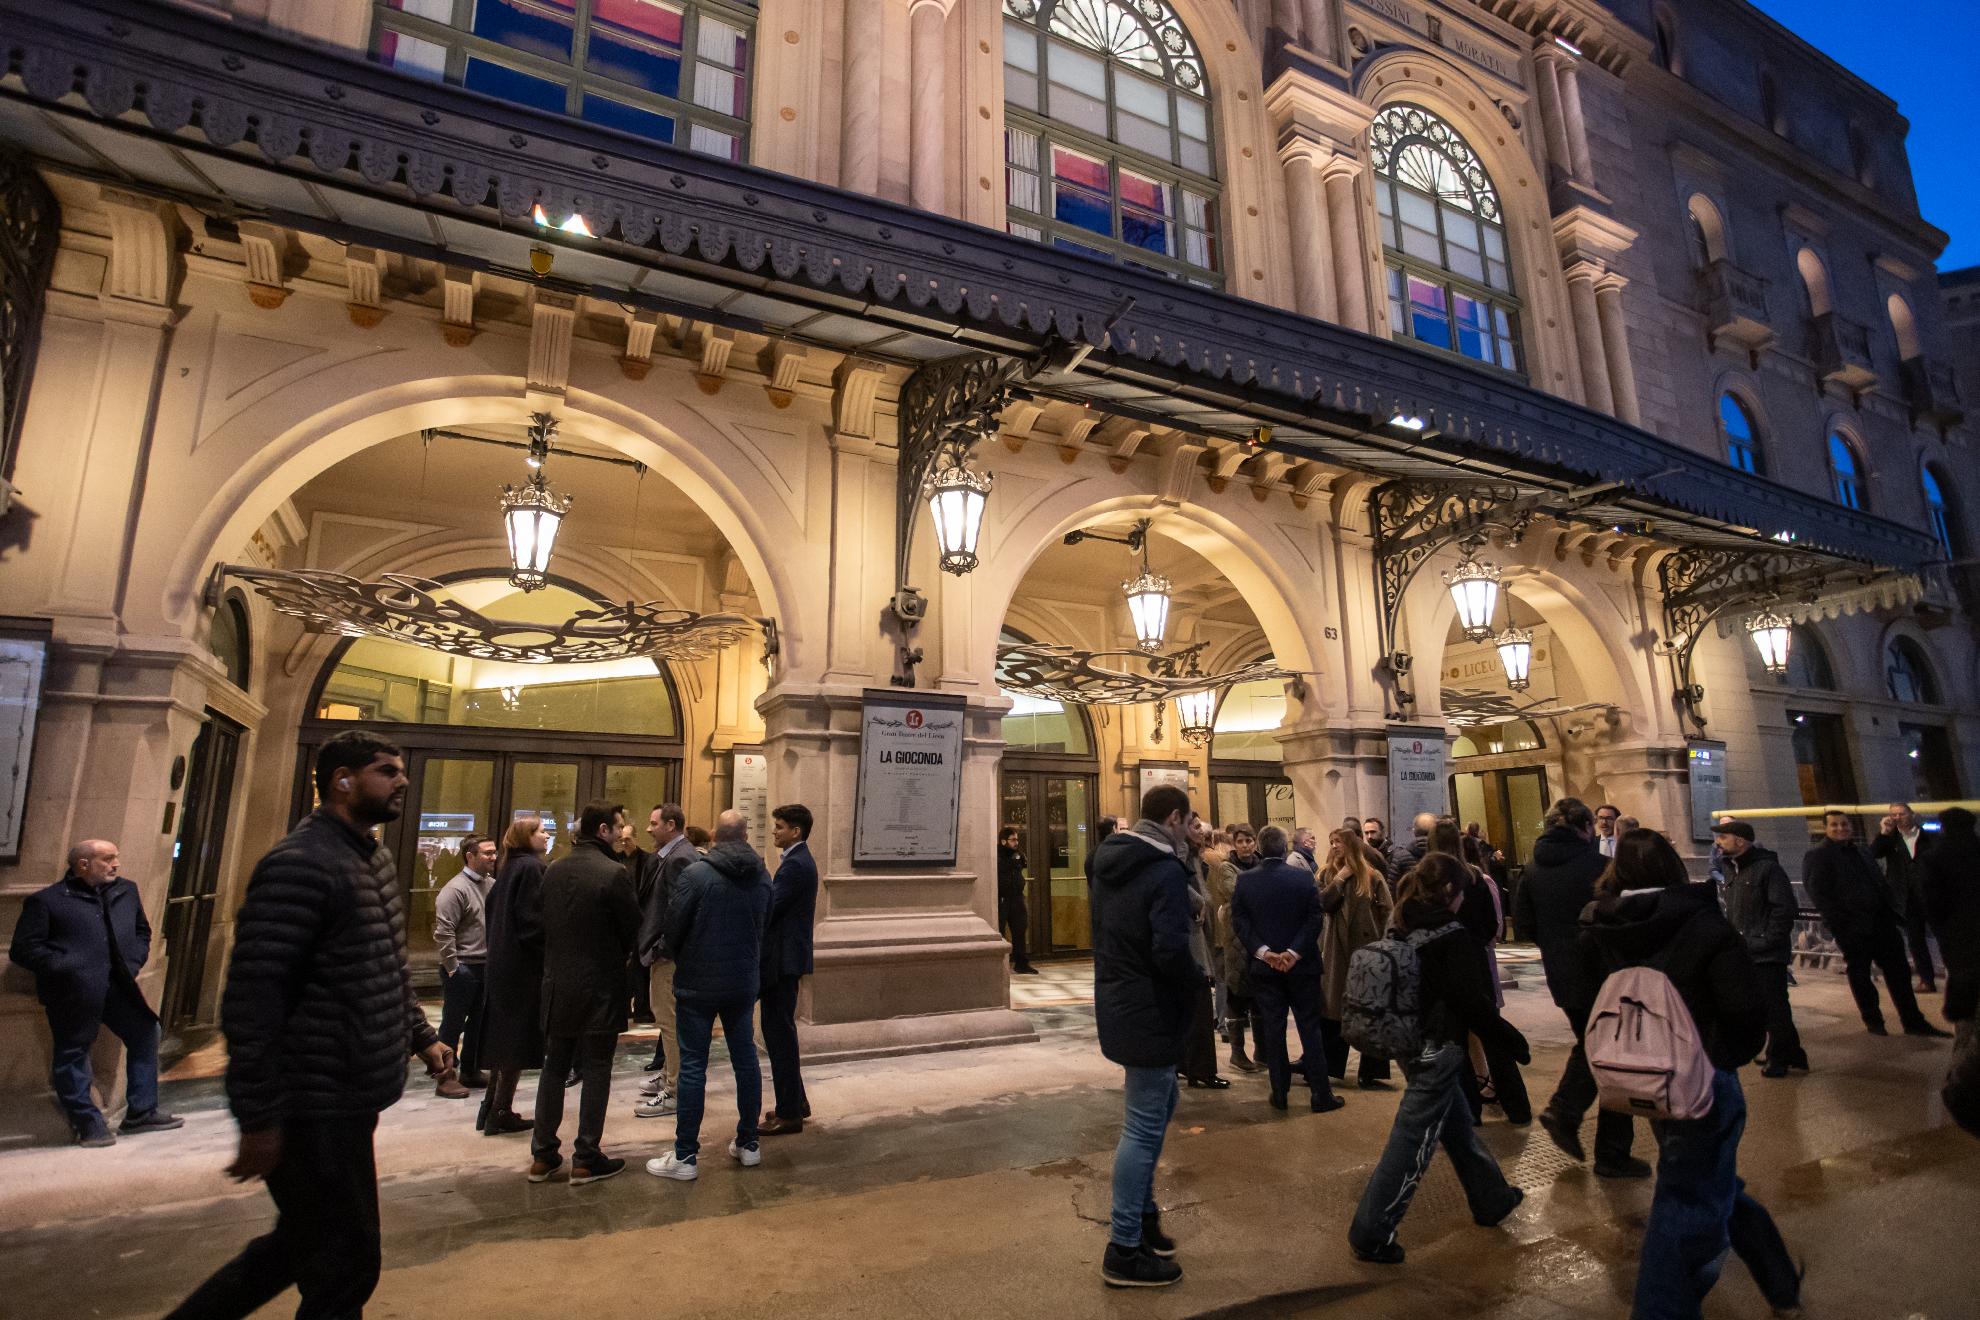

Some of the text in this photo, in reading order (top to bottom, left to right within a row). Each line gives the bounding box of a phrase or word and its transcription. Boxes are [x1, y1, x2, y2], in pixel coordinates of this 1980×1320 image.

[1324, 626, 1338, 641] 63
[1463, 659, 1497, 678] LICEU
[880, 750, 943, 765] LA GIOCONDA
[1400, 771, 1408, 781] LA
